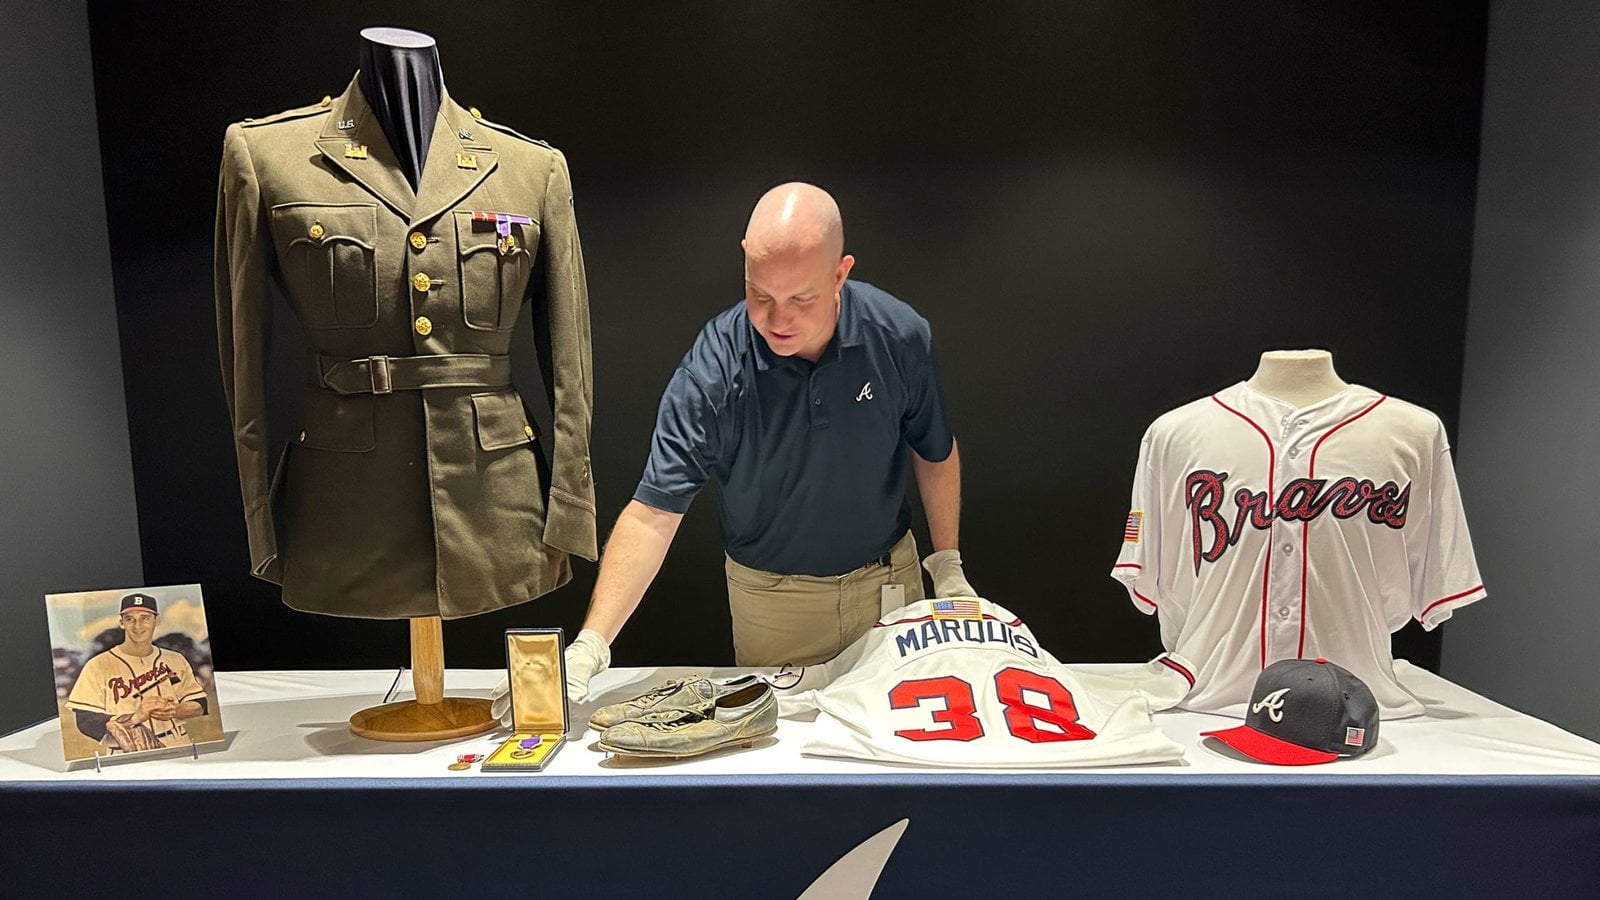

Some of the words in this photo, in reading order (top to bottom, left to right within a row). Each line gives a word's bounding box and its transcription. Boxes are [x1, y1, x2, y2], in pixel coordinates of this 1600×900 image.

[856, 382, 873, 402] A
[1185, 469, 1411, 577] Braves
[134, 597, 143, 605] B
[895, 619, 1038, 658] MARQUIS
[888, 667, 1097, 743] 38
[1252, 687, 1291, 723] A
